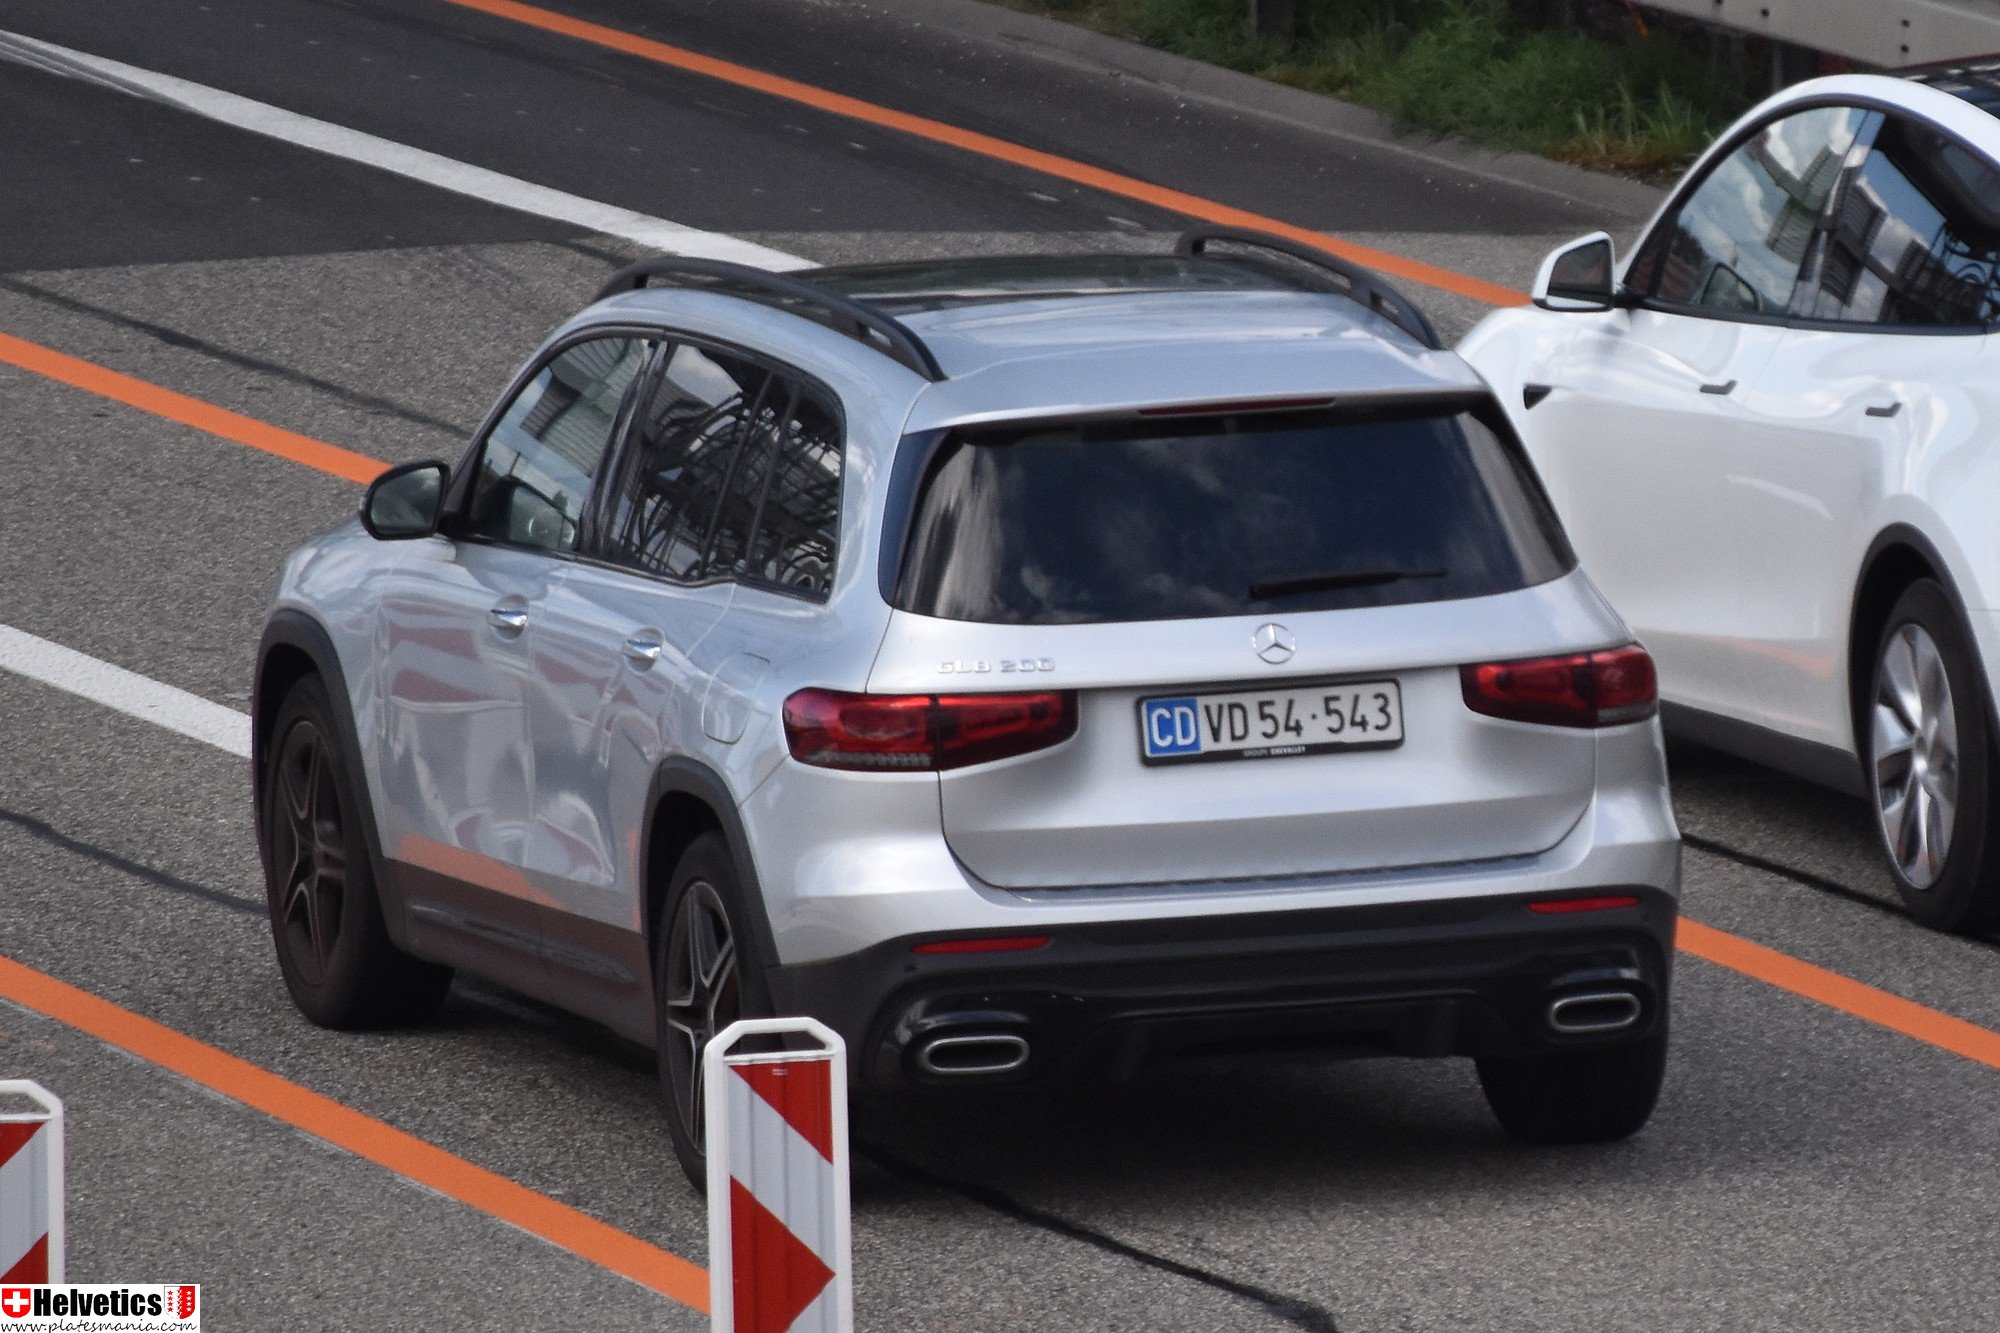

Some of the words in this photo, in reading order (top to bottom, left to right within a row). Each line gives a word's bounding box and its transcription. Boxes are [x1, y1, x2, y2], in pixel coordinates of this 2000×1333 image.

[938, 661, 992, 674] GLB
[1000, 656, 1056, 673] 200
[1151, 706, 1197, 748] CD
